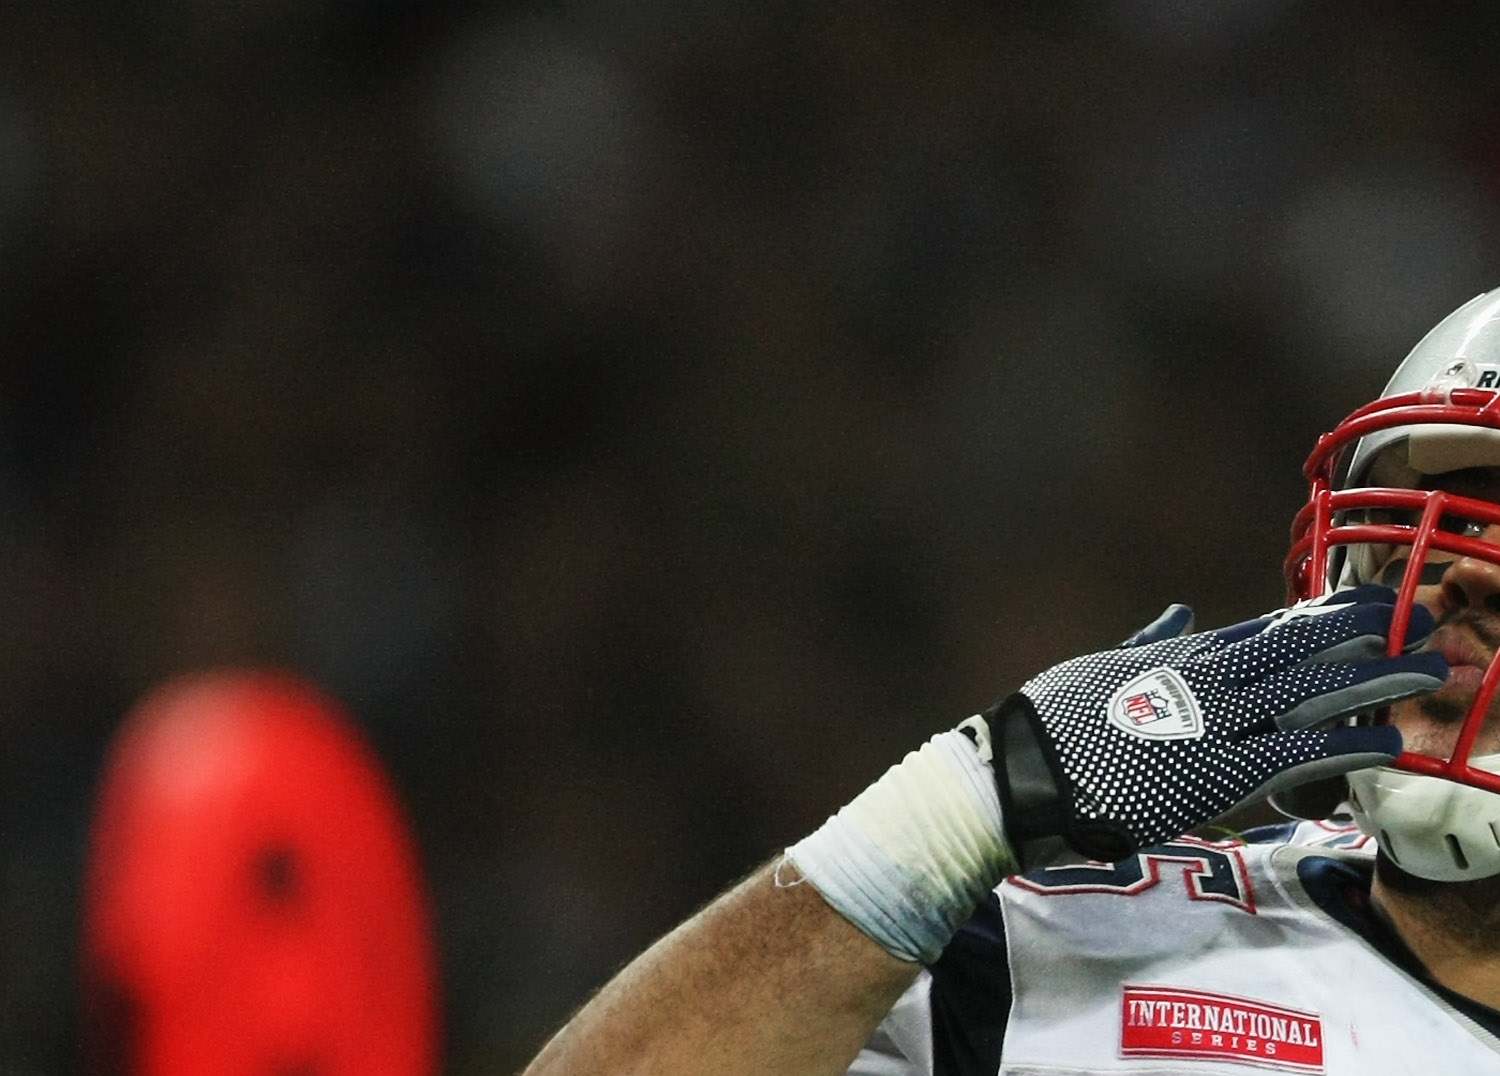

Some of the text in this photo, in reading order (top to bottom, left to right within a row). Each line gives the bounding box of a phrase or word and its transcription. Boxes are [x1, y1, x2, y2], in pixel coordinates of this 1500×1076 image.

[1126, 694, 1155, 725] NFL
[1128, 999, 1318, 1047] INTERNATIONAL
[1171, 1031, 1277, 1055] SERIES
